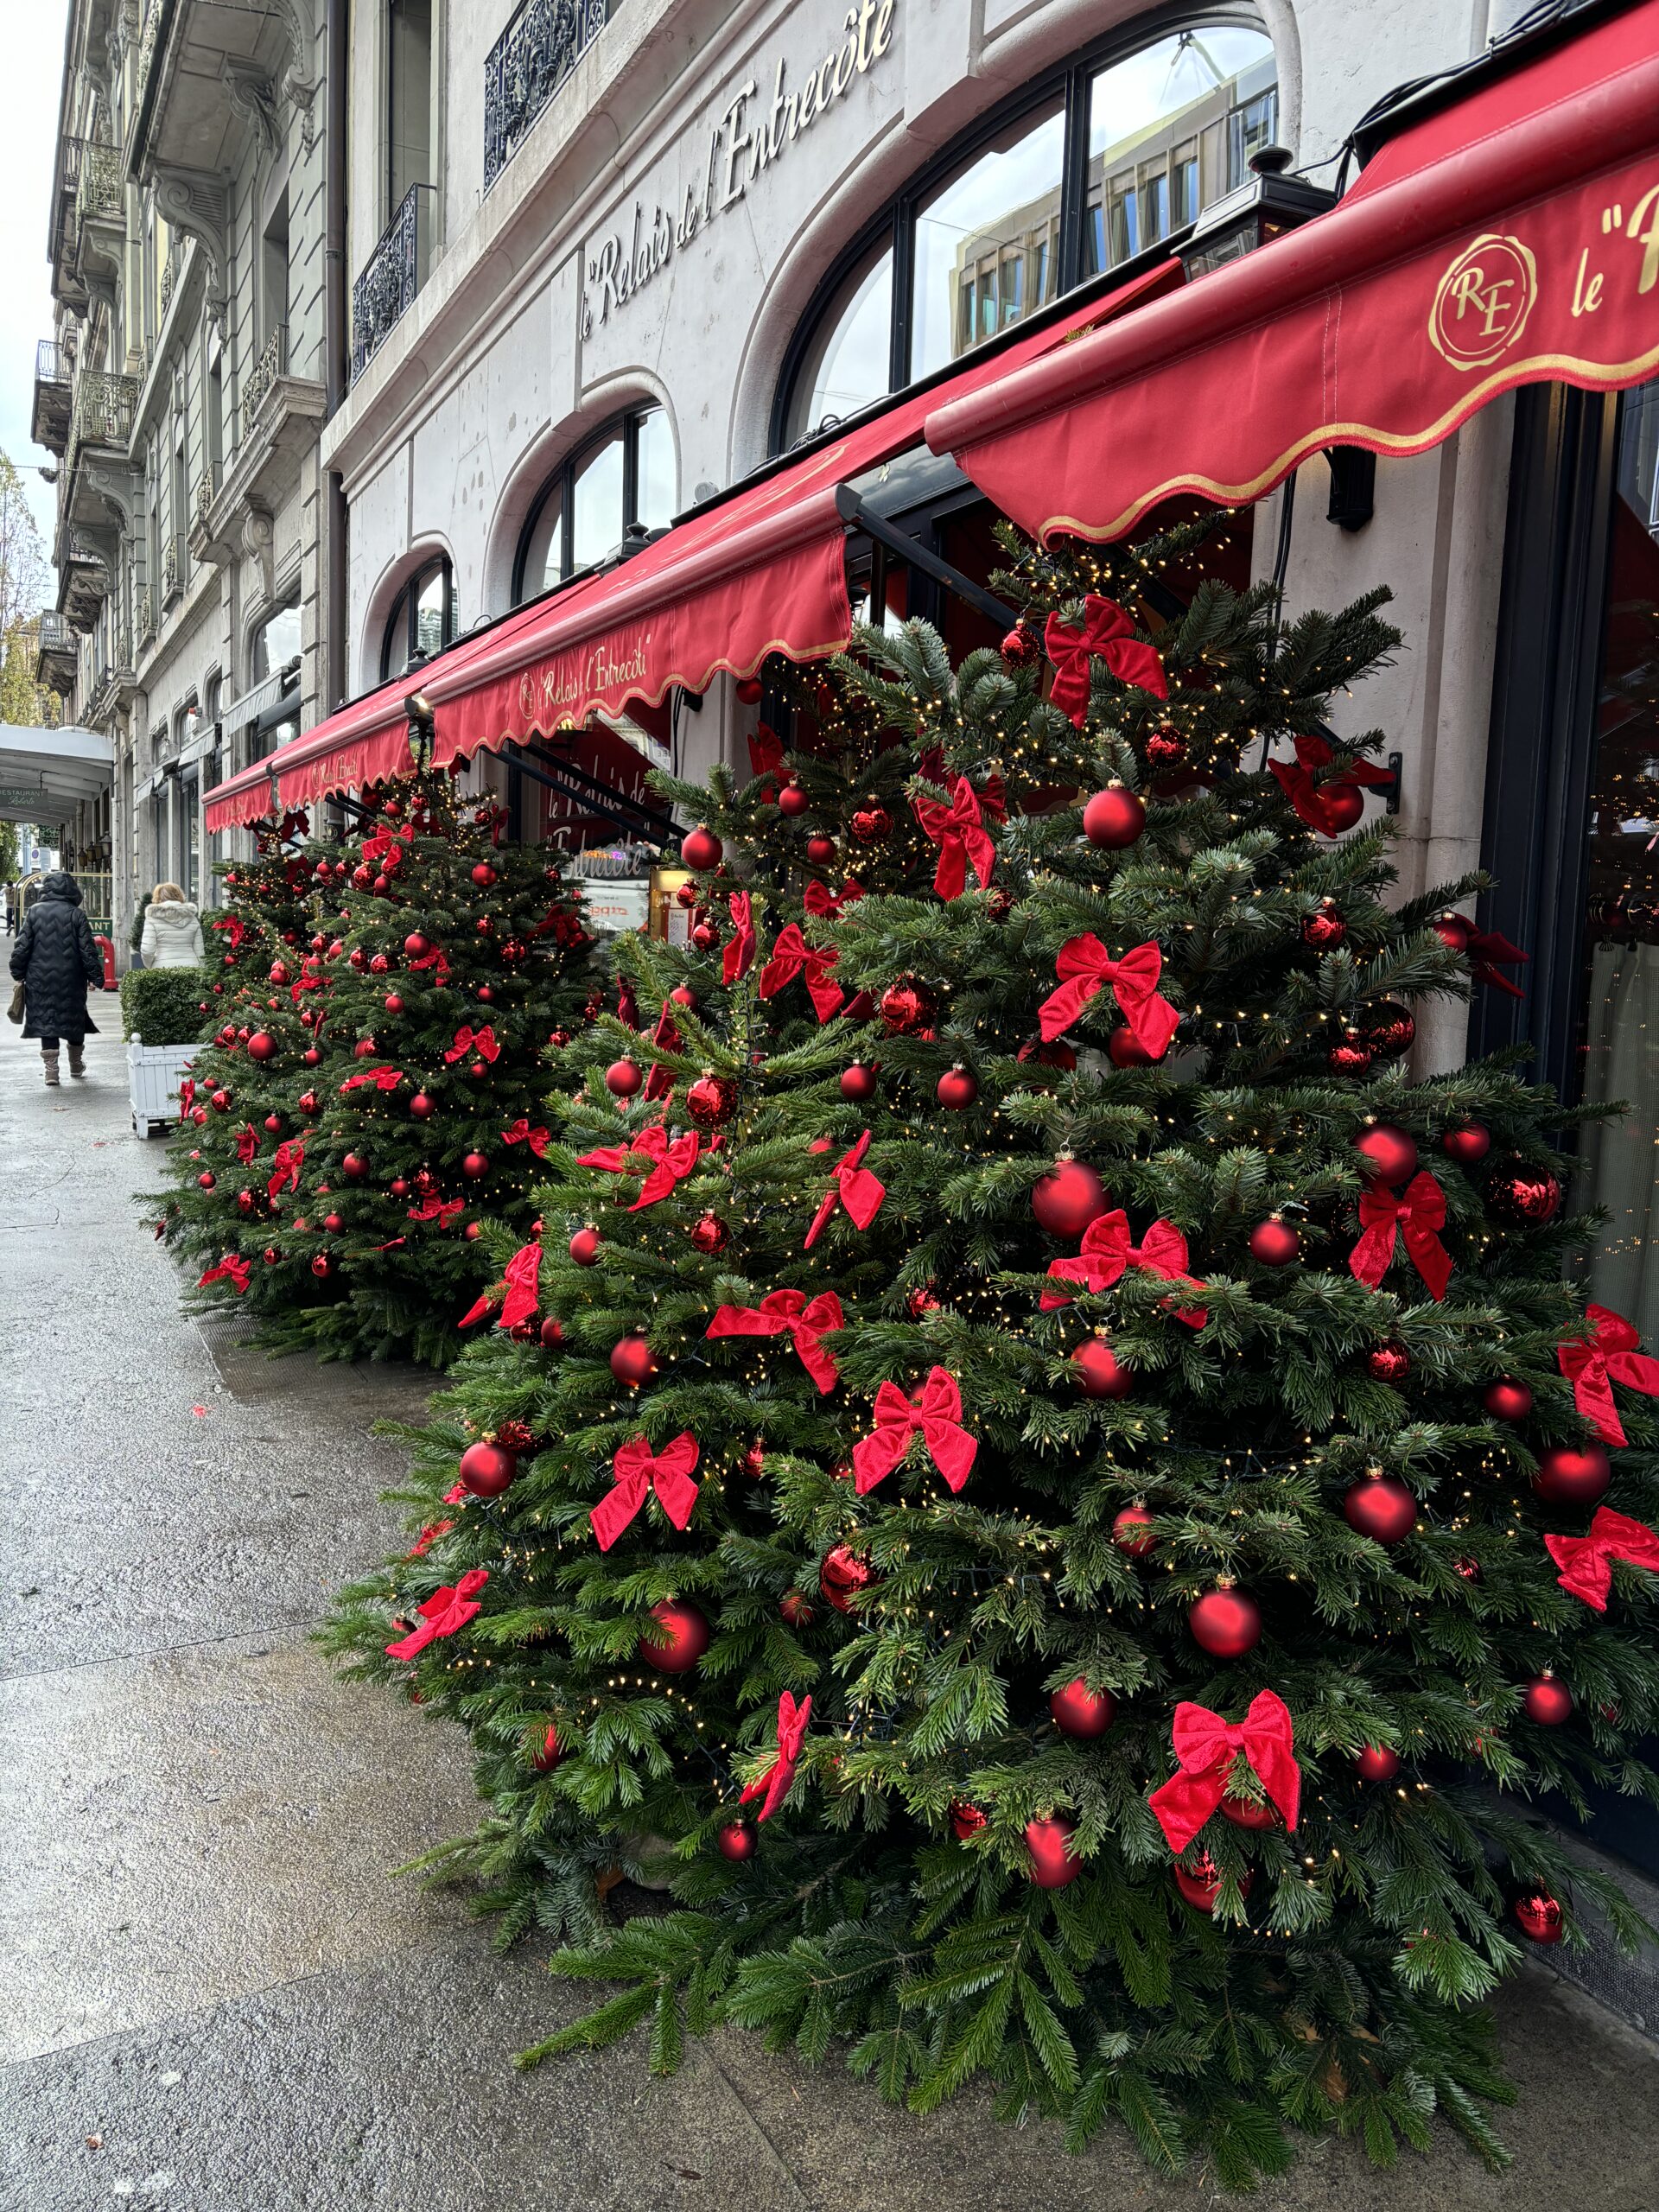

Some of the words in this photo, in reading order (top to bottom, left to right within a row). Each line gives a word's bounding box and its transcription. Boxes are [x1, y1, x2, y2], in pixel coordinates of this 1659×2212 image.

[578, 290, 591, 341] le
[674, 184, 697, 249] de
[1452, 267, 1515, 336] RE
[1572, 247, 1604, 317] le
[549, 788, 558, 818] le
[630, 771, 645, 805] de
